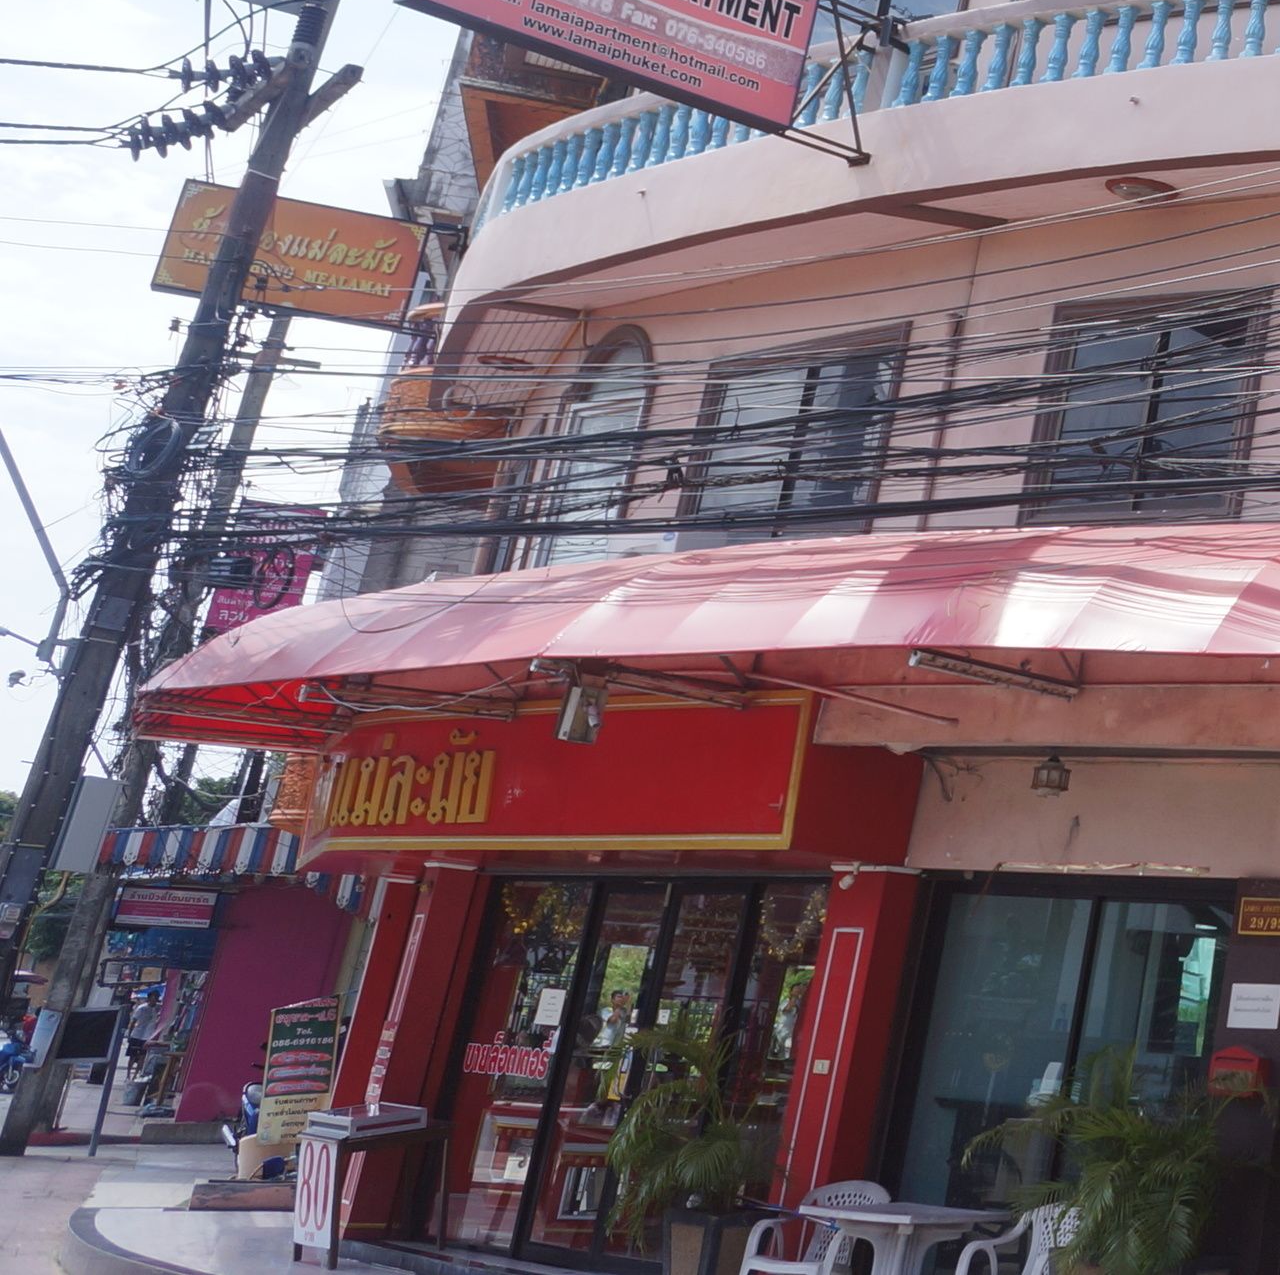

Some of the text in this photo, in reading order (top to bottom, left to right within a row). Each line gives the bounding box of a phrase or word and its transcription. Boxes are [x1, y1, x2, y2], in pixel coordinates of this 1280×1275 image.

[522, 14, 702, 88] www.lamaiphuket.com
[620, 1, 658, 30] Fax:
[664, 18, 768, 70] 076-340586
[303, 268, 393, 298] MEALAMAI
[299, 1141, 331, 1232] 80
